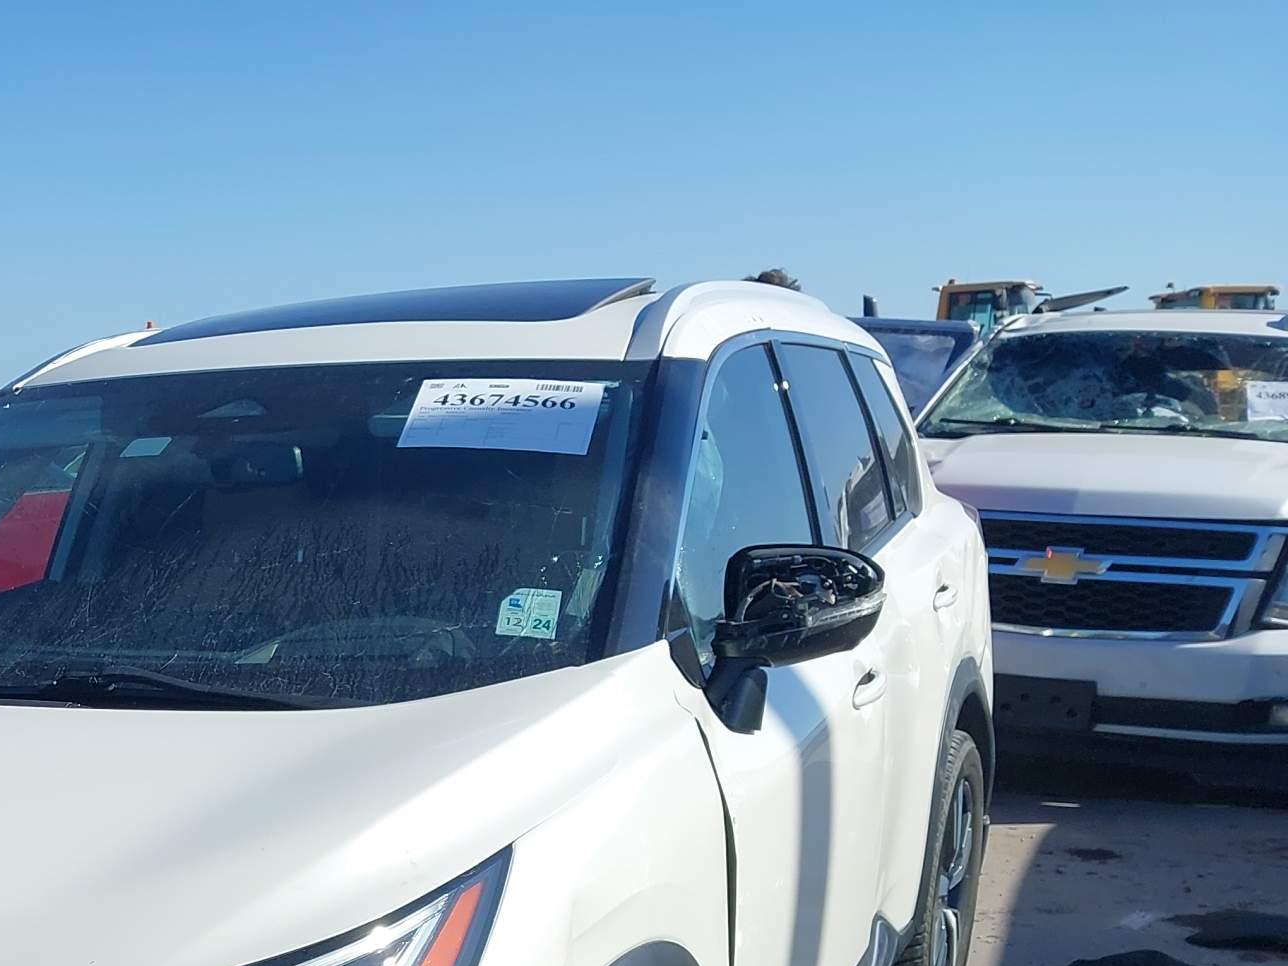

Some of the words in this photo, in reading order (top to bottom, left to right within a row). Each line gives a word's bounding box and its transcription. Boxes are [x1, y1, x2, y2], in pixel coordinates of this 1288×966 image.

[433, 392, 576, 410] 43674566
[1255, 391, 1288, 400] 4368
[505, 616, 522, 627] 12
[532, 618, 551, 631] 24
